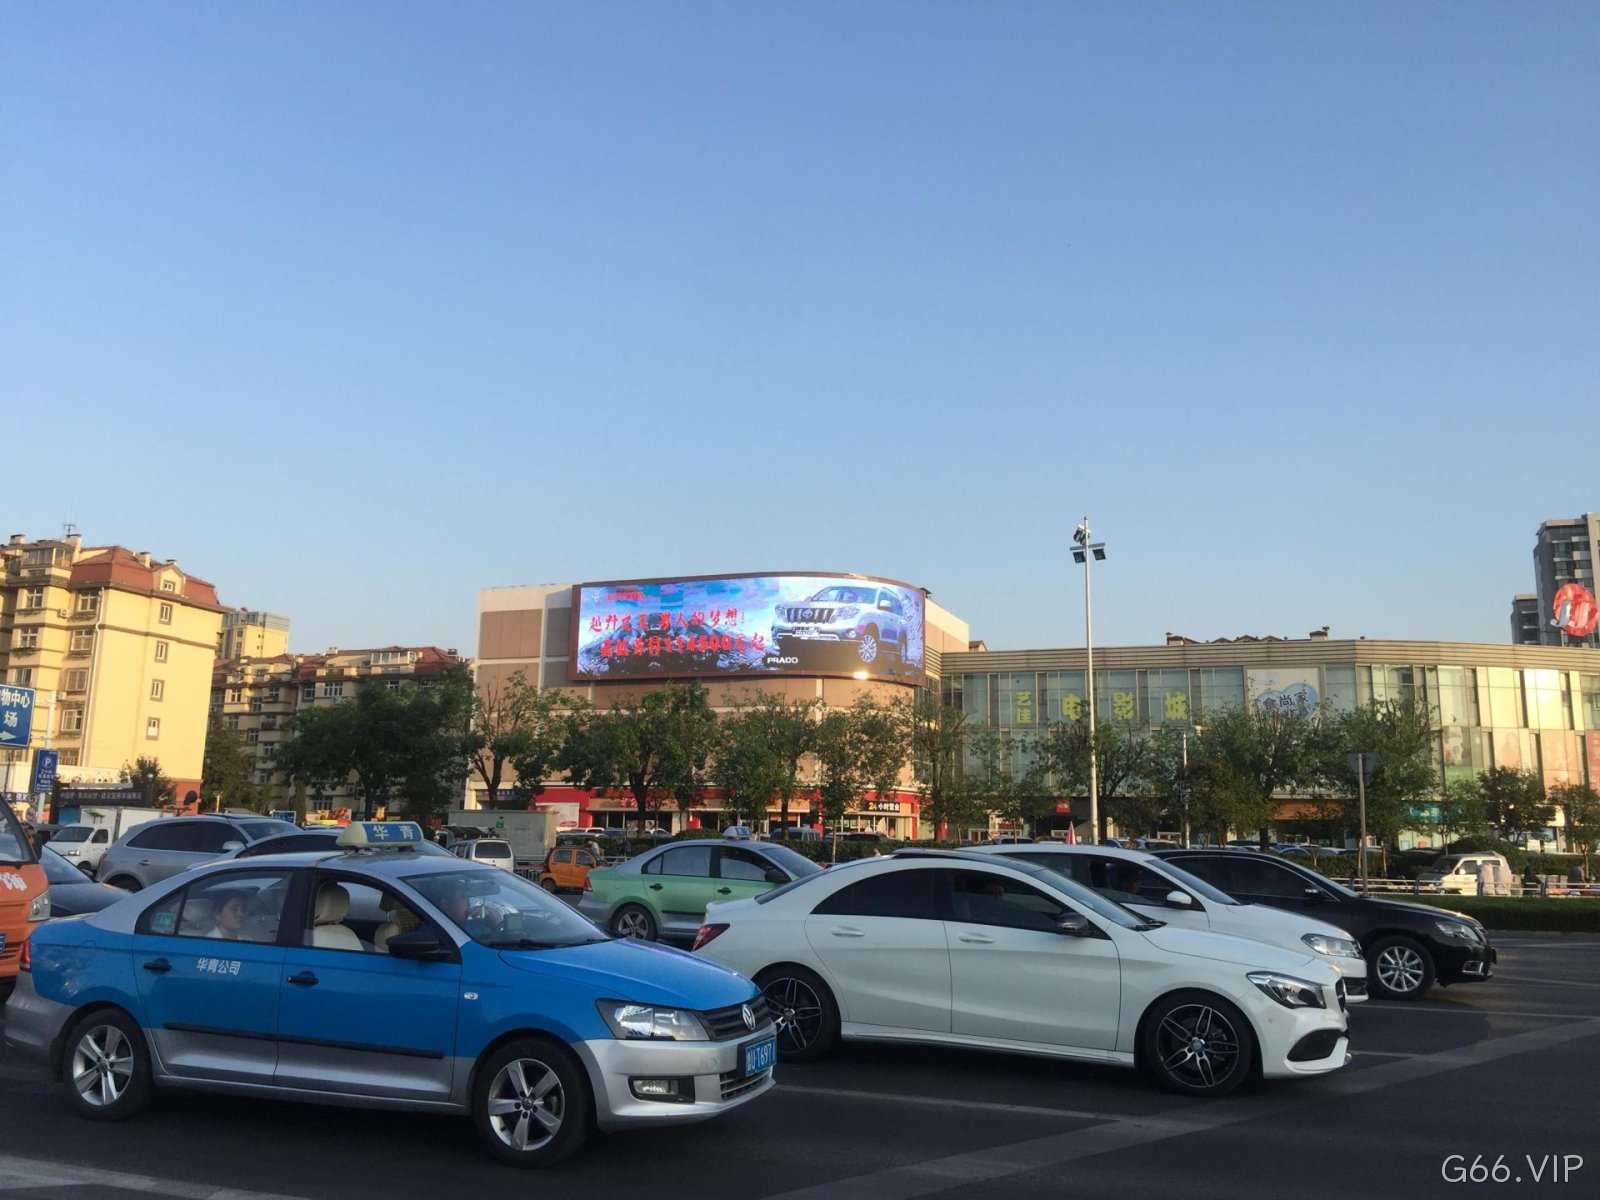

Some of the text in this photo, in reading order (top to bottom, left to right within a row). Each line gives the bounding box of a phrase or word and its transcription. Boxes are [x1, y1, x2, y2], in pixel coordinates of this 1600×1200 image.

[766, 656, 799, 664] PRADO
[0, 688, 31, 709] 物中心
[3, 710, 18, 728] 场
[373, 824, 414, 841] 华青
[0, 871, 27, 891] 饰
[196, 957, 241, 976] 华青公司
